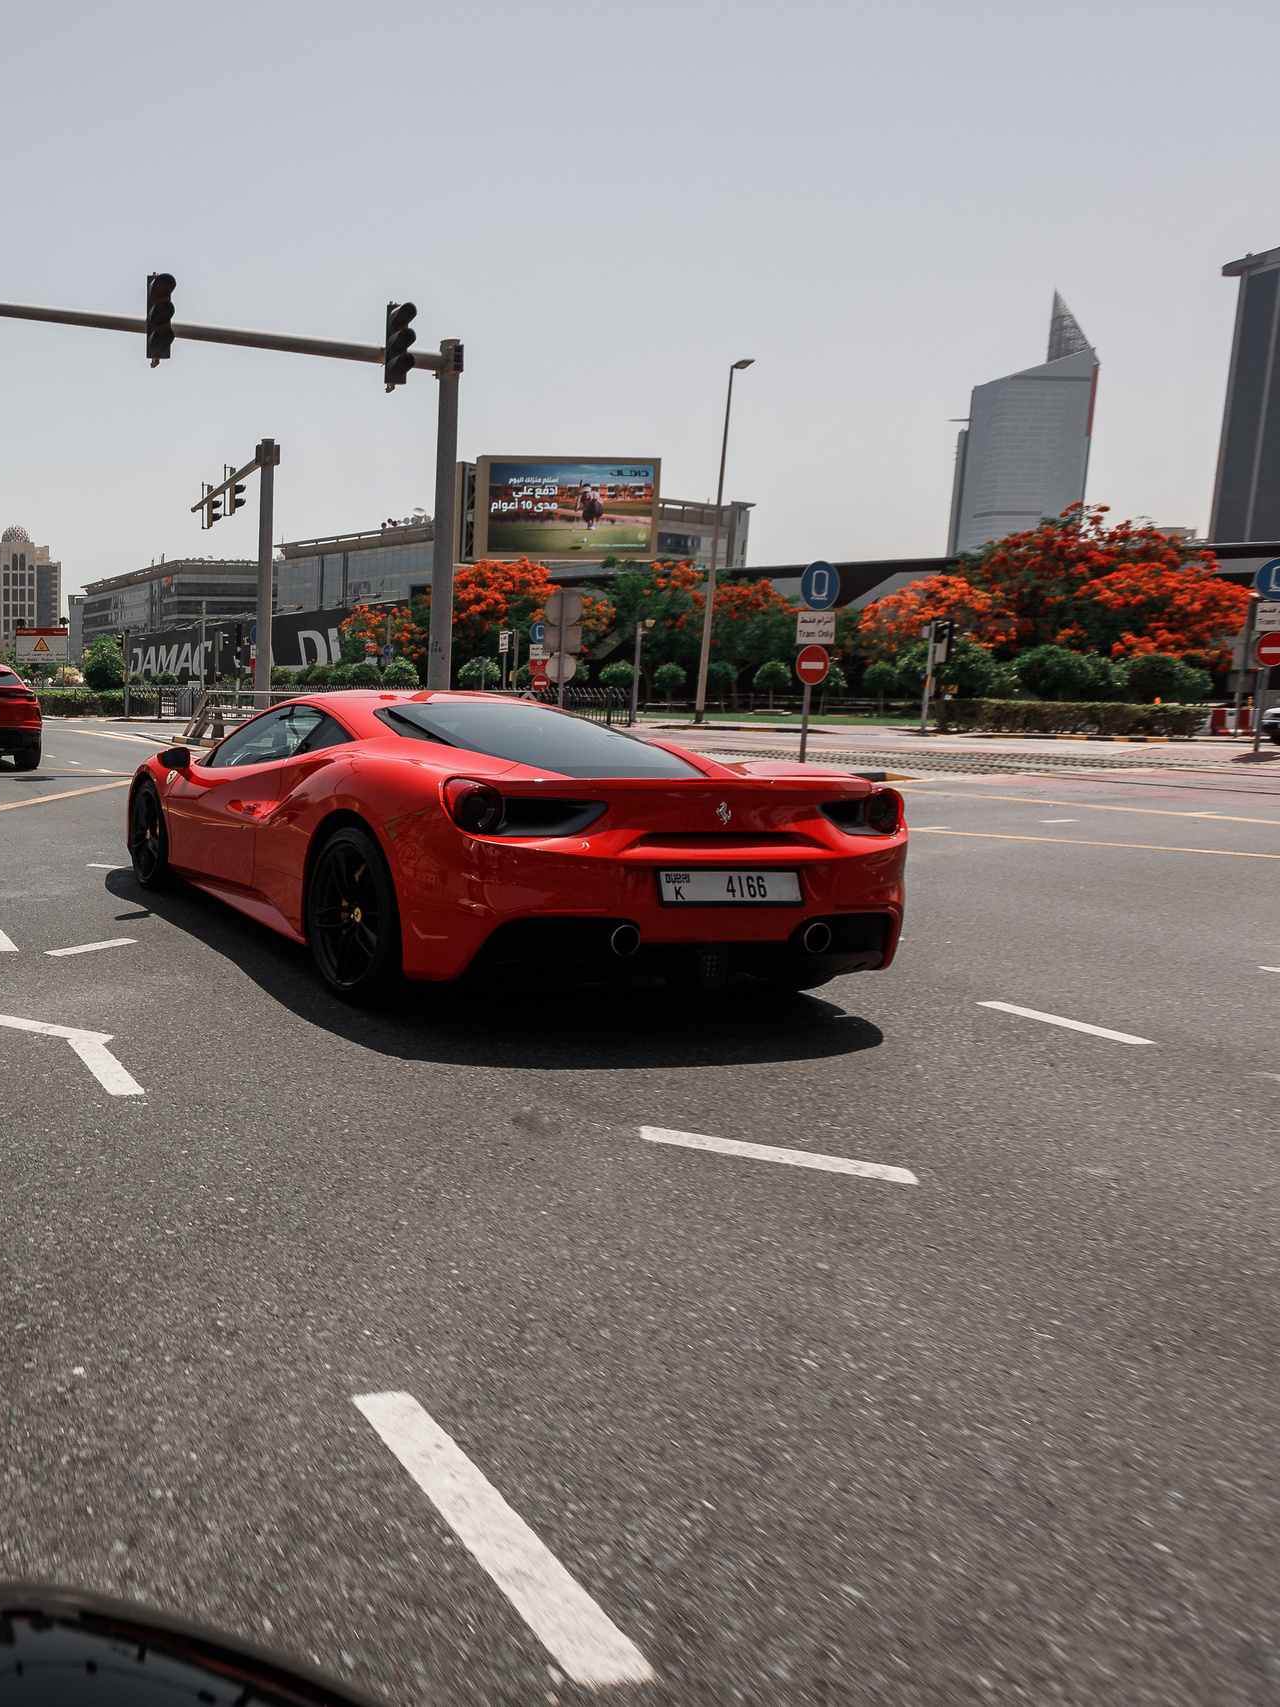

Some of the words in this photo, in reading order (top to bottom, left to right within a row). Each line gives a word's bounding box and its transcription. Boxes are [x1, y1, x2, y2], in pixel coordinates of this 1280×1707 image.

[520, 500, 533, 510] 10
[799, 630, 816, 638] Tram
[818, 630, 834, 639] Only
[129, 640, 213, 676] DAMAC
[674, 886, 685, 900] K
[726, 875, 768, 898] 4166
